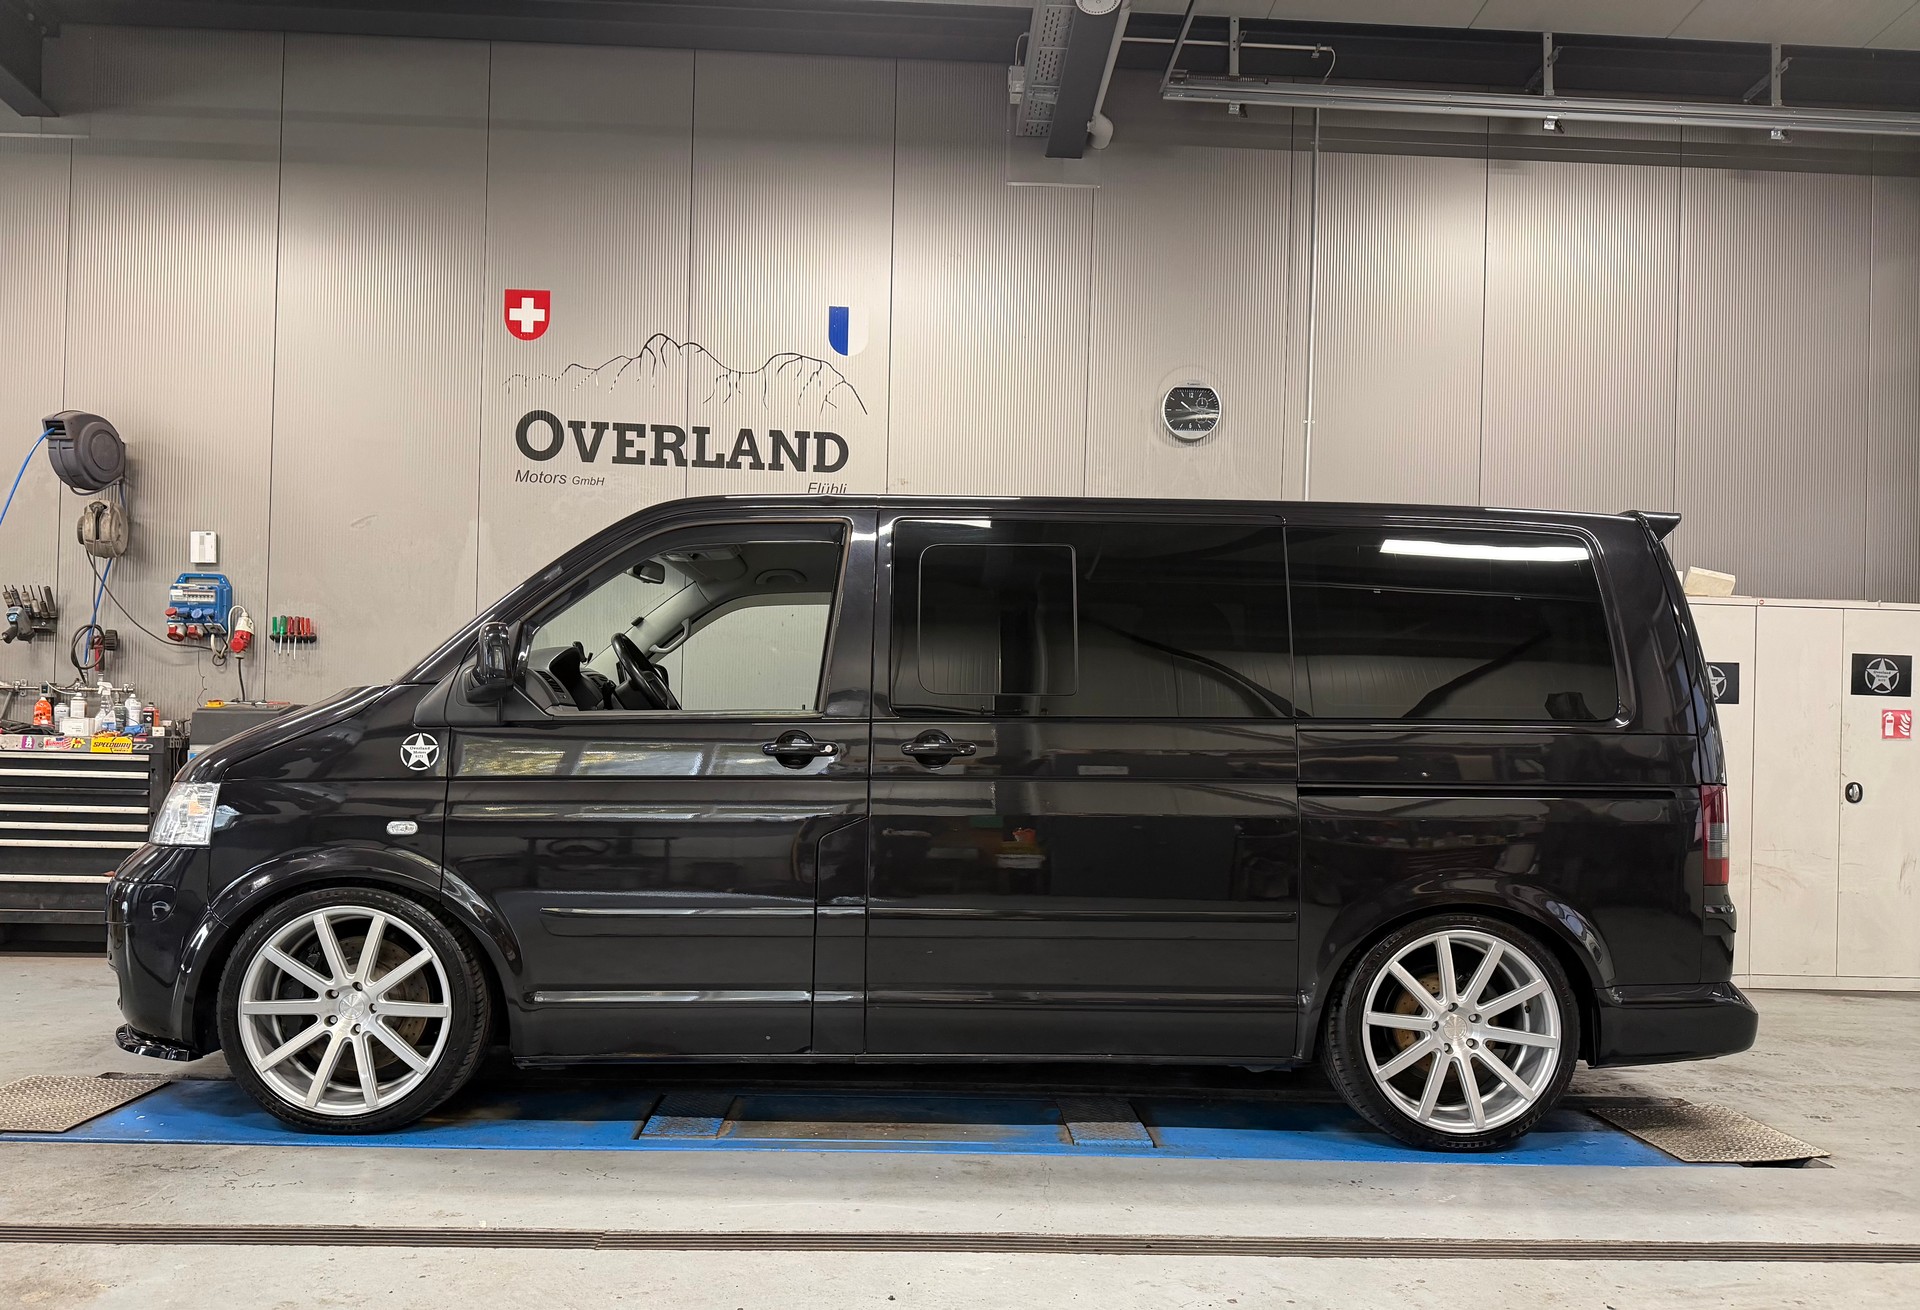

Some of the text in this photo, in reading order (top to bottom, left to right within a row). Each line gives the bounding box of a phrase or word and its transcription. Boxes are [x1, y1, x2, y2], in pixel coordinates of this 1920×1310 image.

[515, 409, 849, 473] OVERLAND
[515, 469, 605, 486] Motors GmbH
